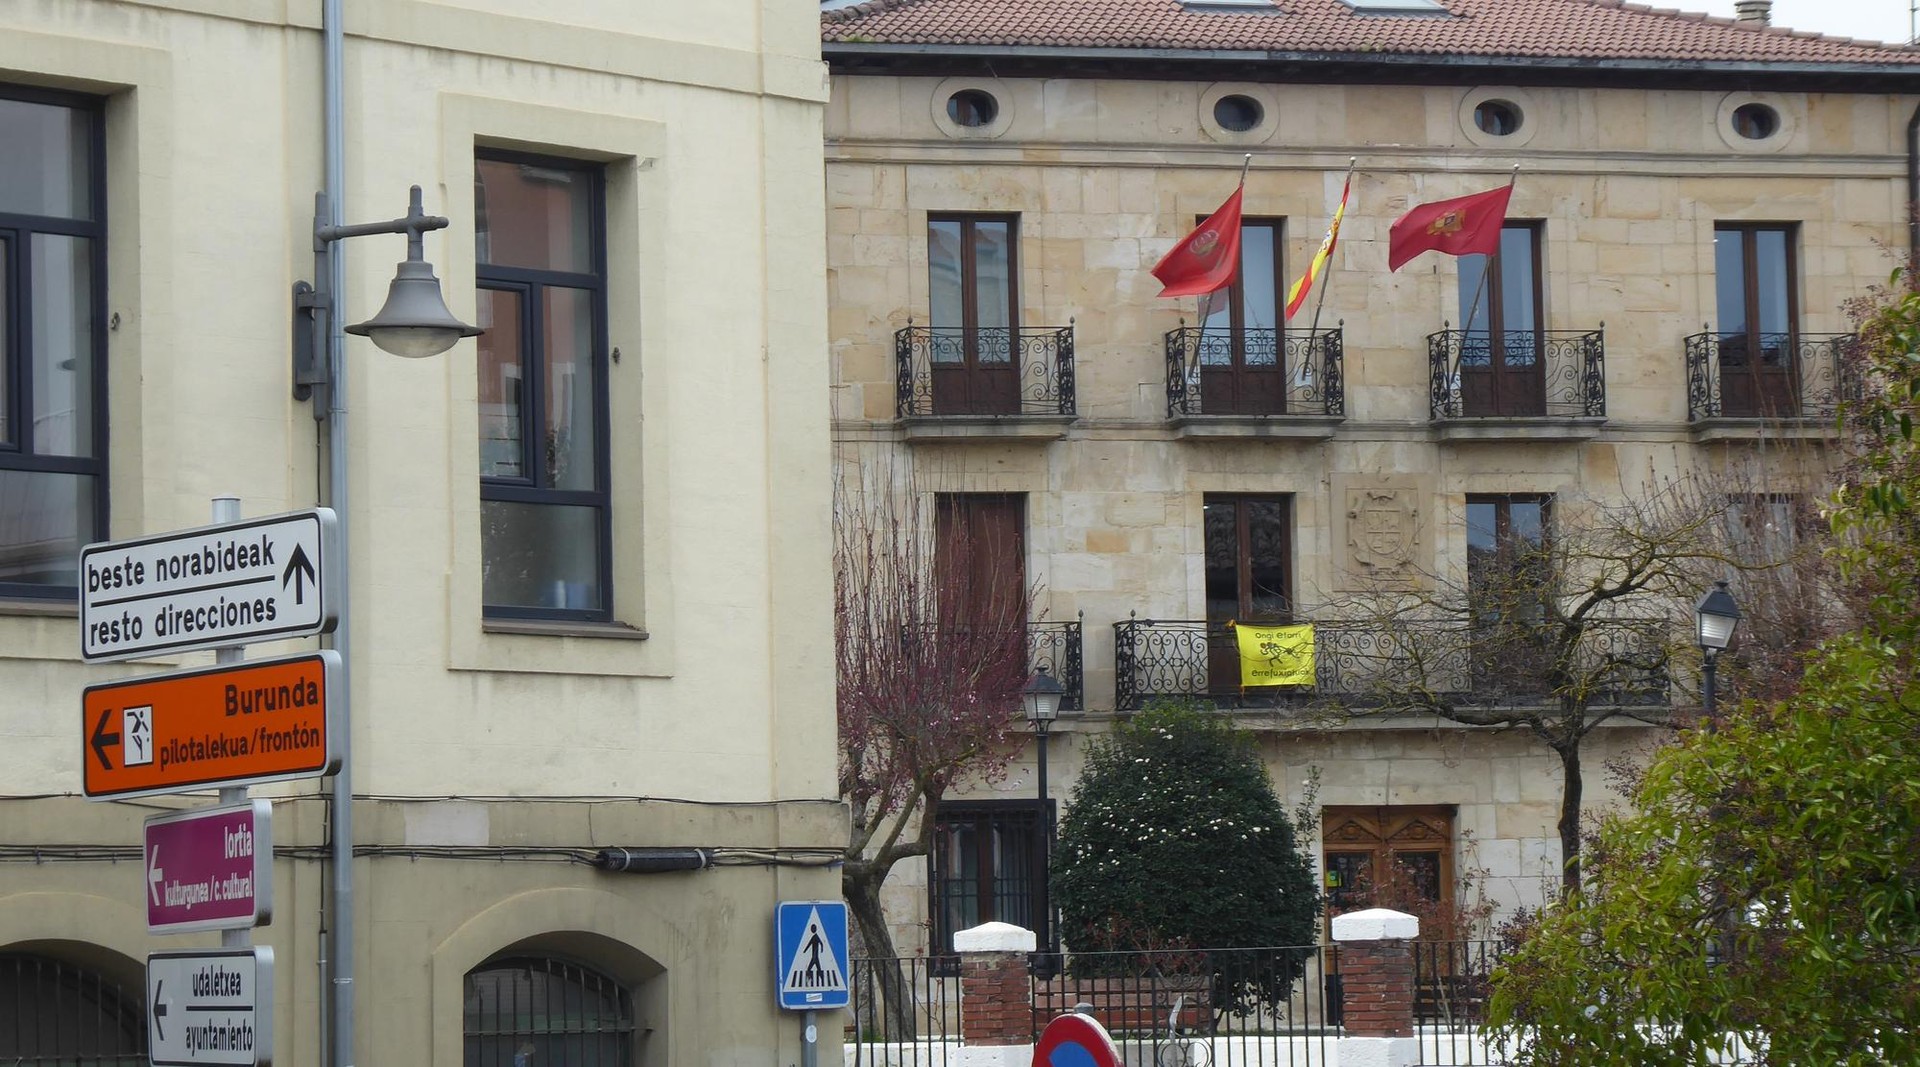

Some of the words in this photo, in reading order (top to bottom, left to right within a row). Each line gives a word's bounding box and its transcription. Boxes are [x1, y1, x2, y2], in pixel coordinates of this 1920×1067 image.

[88, 556, 145, 593] beste
[156, 534, 275, 582] norabideak
[90, 611, 143, 646] resto
[155, 596, 276, 637] direcciones
[225, 677, 318, 716] Burunda
[222, 870, 253, 900] cultural
[192, 965, 242, 997] udaletxea
[186, 1018, 253, 1056] ayuntamiento
